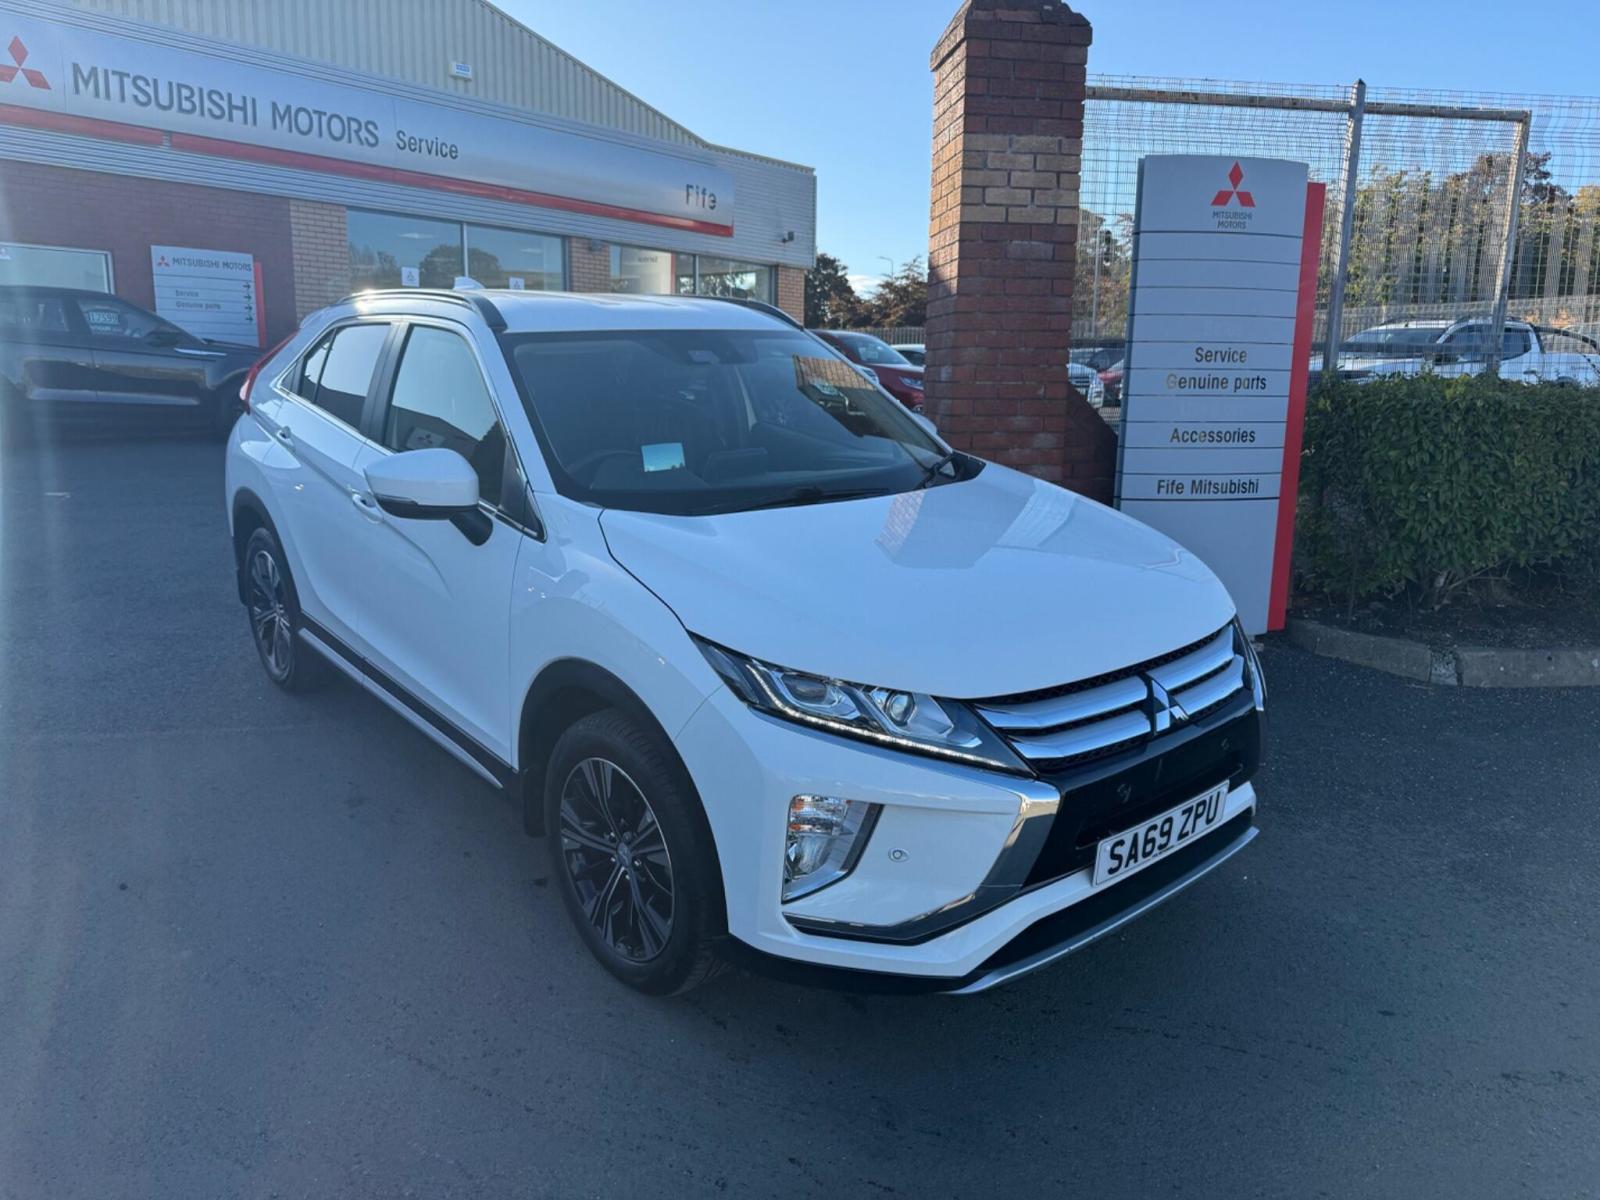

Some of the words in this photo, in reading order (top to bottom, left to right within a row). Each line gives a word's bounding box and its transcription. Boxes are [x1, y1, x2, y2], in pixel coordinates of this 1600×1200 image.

[72, 62, 257, 127] MITSUBISHI
[271, 101, 379, 148] MOTORS
[396, 130, 459, 160] Service
[1212, 211, 1252, 221] MITSUBISHI
[1217, 221, 1247, 230] MOTORS
[172, 257, 219, 269] MITSUBISHI
[222, 261, 252, 272] MOTORS
[1195, 347, 1247, 363] Service
[1167, 374, 1229, 390] Genuine
[1234, 376, 1267, 393] parts
[1170, 428, 1256, 443] Accessories
[1157, 479, 1184, 495] Fife
[1190, 479, 1259, 495] Mitsubishi
[1107, 816, 1174, 875] SA69
[1177, 791, 1222, 841] ZPU
